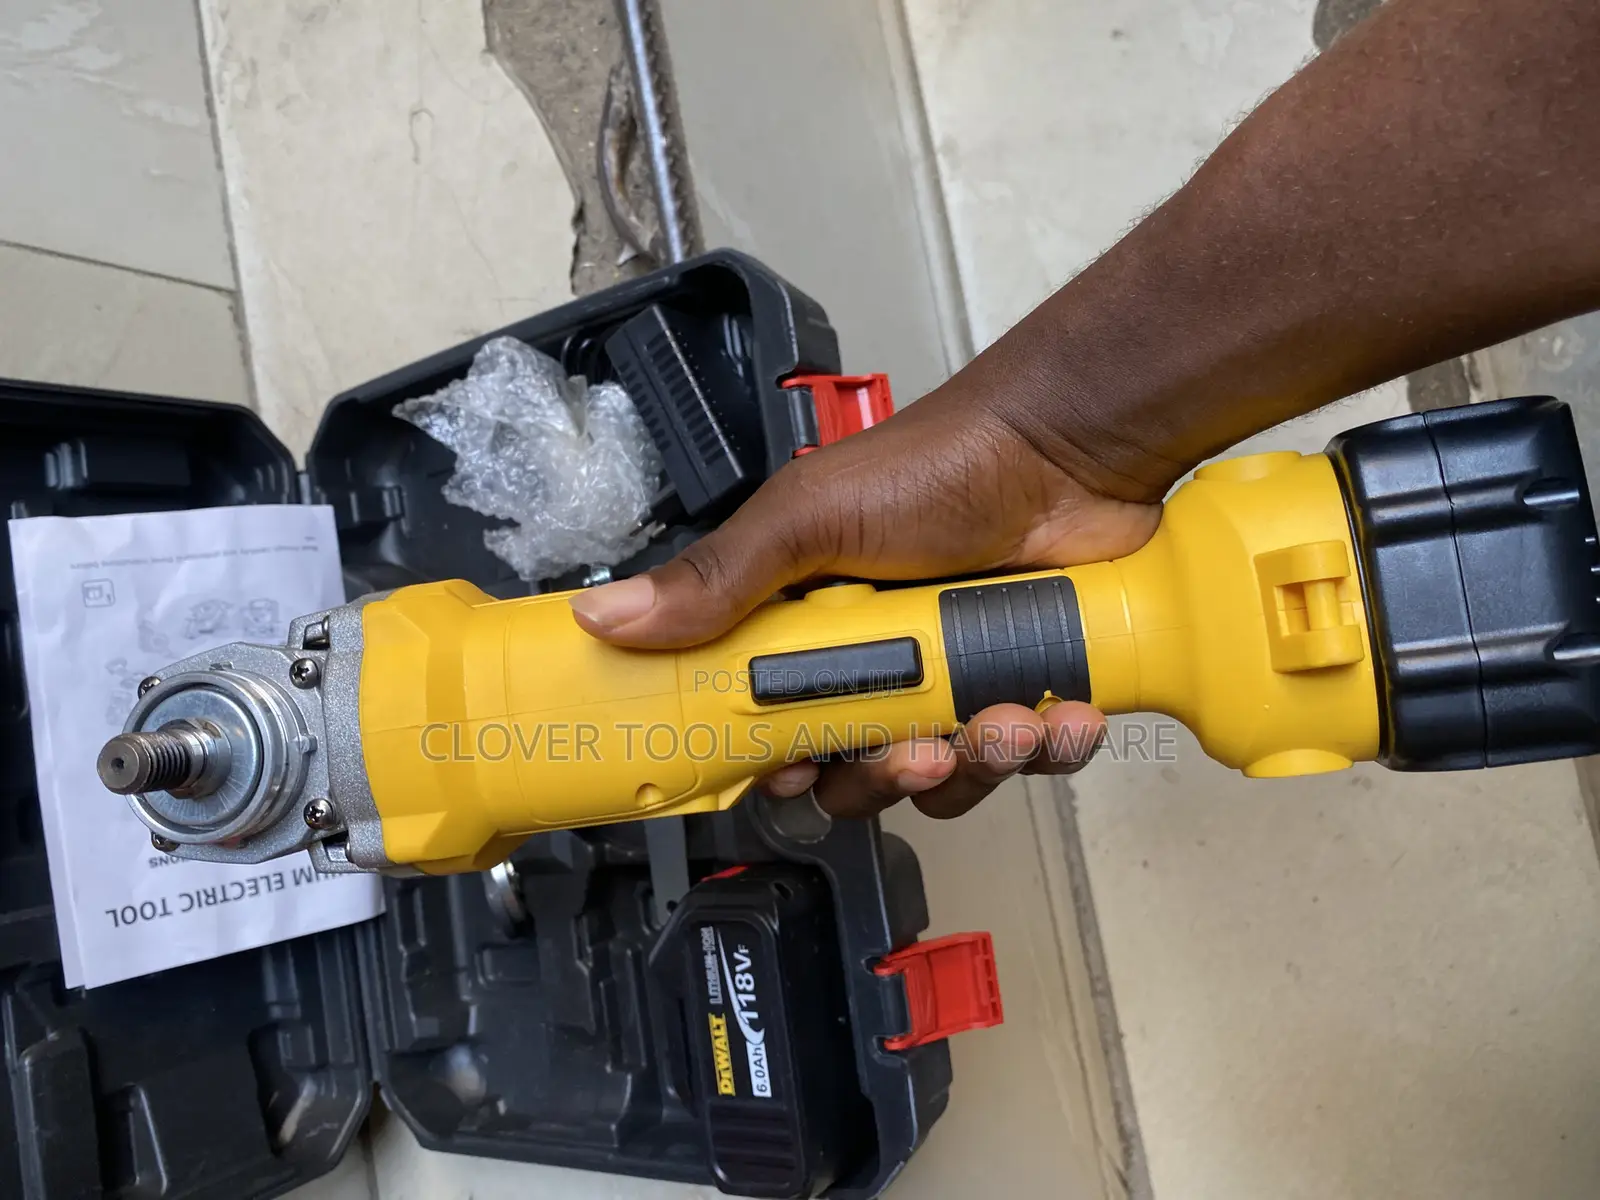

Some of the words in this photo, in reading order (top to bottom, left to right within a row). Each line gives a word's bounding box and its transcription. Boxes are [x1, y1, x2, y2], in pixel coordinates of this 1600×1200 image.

[105, 898, 172, 928] TOOL
[178, 871, 286, 913] ELECTRIC
[753, 1044, 768, 1093] 6.0Ah
